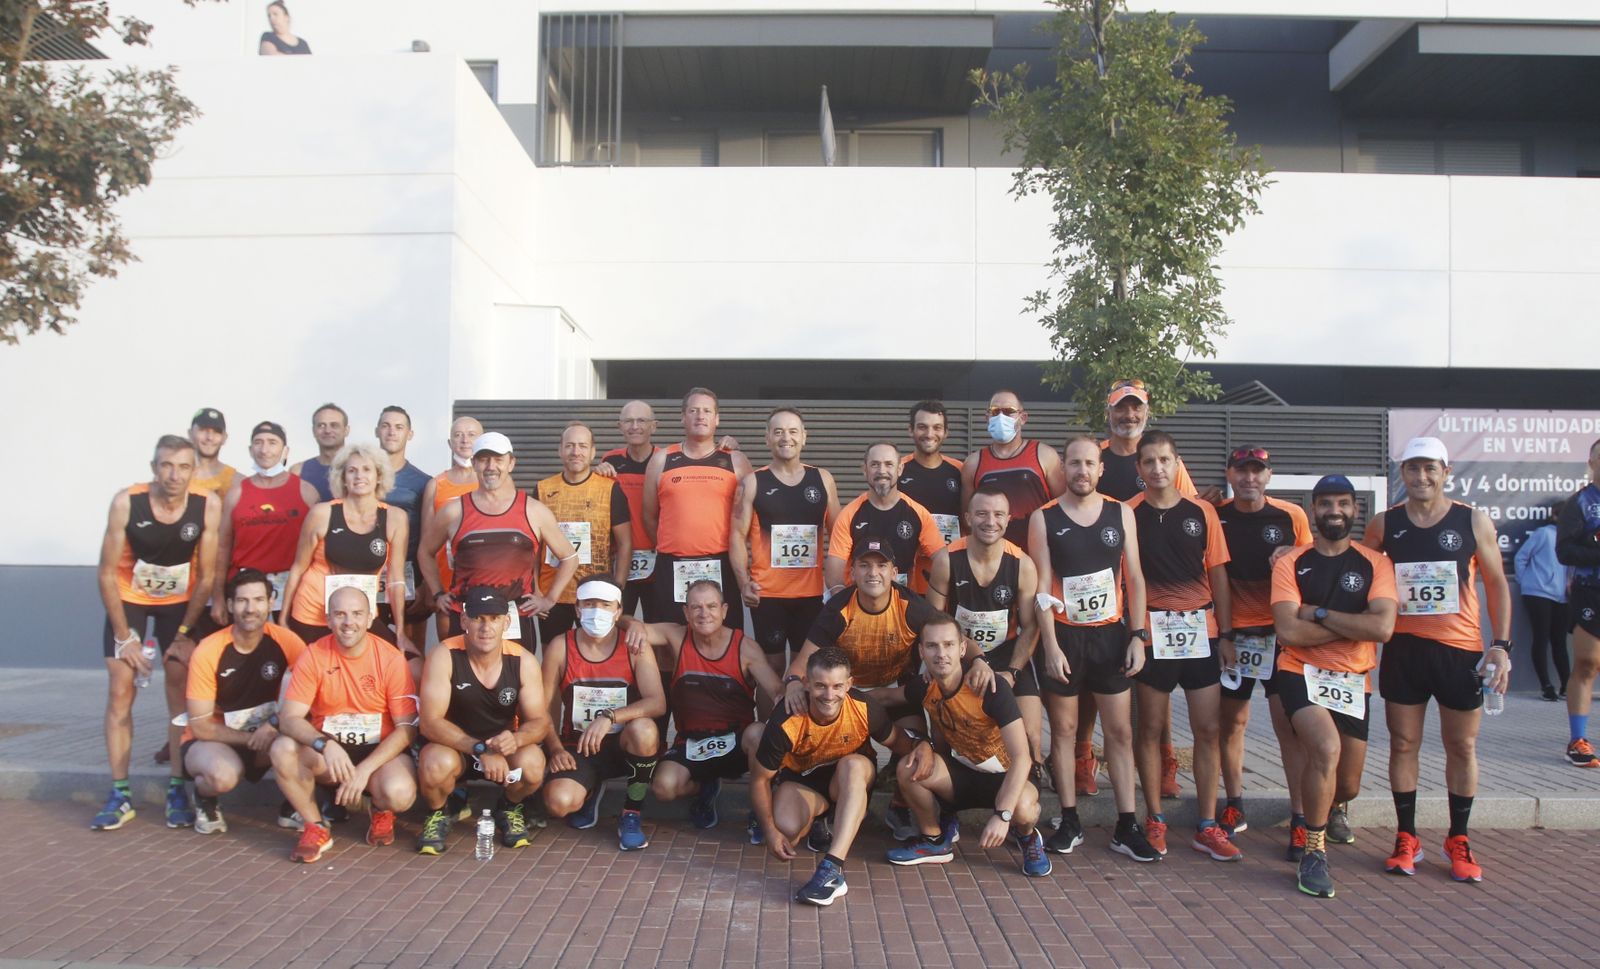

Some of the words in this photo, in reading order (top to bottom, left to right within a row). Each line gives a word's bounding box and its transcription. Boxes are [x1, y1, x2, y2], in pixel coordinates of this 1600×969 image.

[1438, 413, 1517, 433] ÚLTIMAS
[1483, 437, 1506, 453] EN
[1512, 438, 1571, 453] VENTA
[1460, 478, 1473, 497] y
[1477, 475, 1491, 493] 4
[1495, 473, 1593, 492] dormitori
[781, 544, 809, 557] 162
[630, 559, 648, 571] 82
[144, 579, 177, 590] 173
[1408, 585, 1446, 602] 163
[1077, 593, 1108, 612] 167
[965, 628, 997, 642] 185
[1164, 632, 1198, 647] 197
[1235, 651, 1263, 667] 80
[1318, 685, 1353, 704] 203
[583, 708, 603, 721] 16
[335, 732, 369, 745] 181
[698, 740, 728, 755] 168
